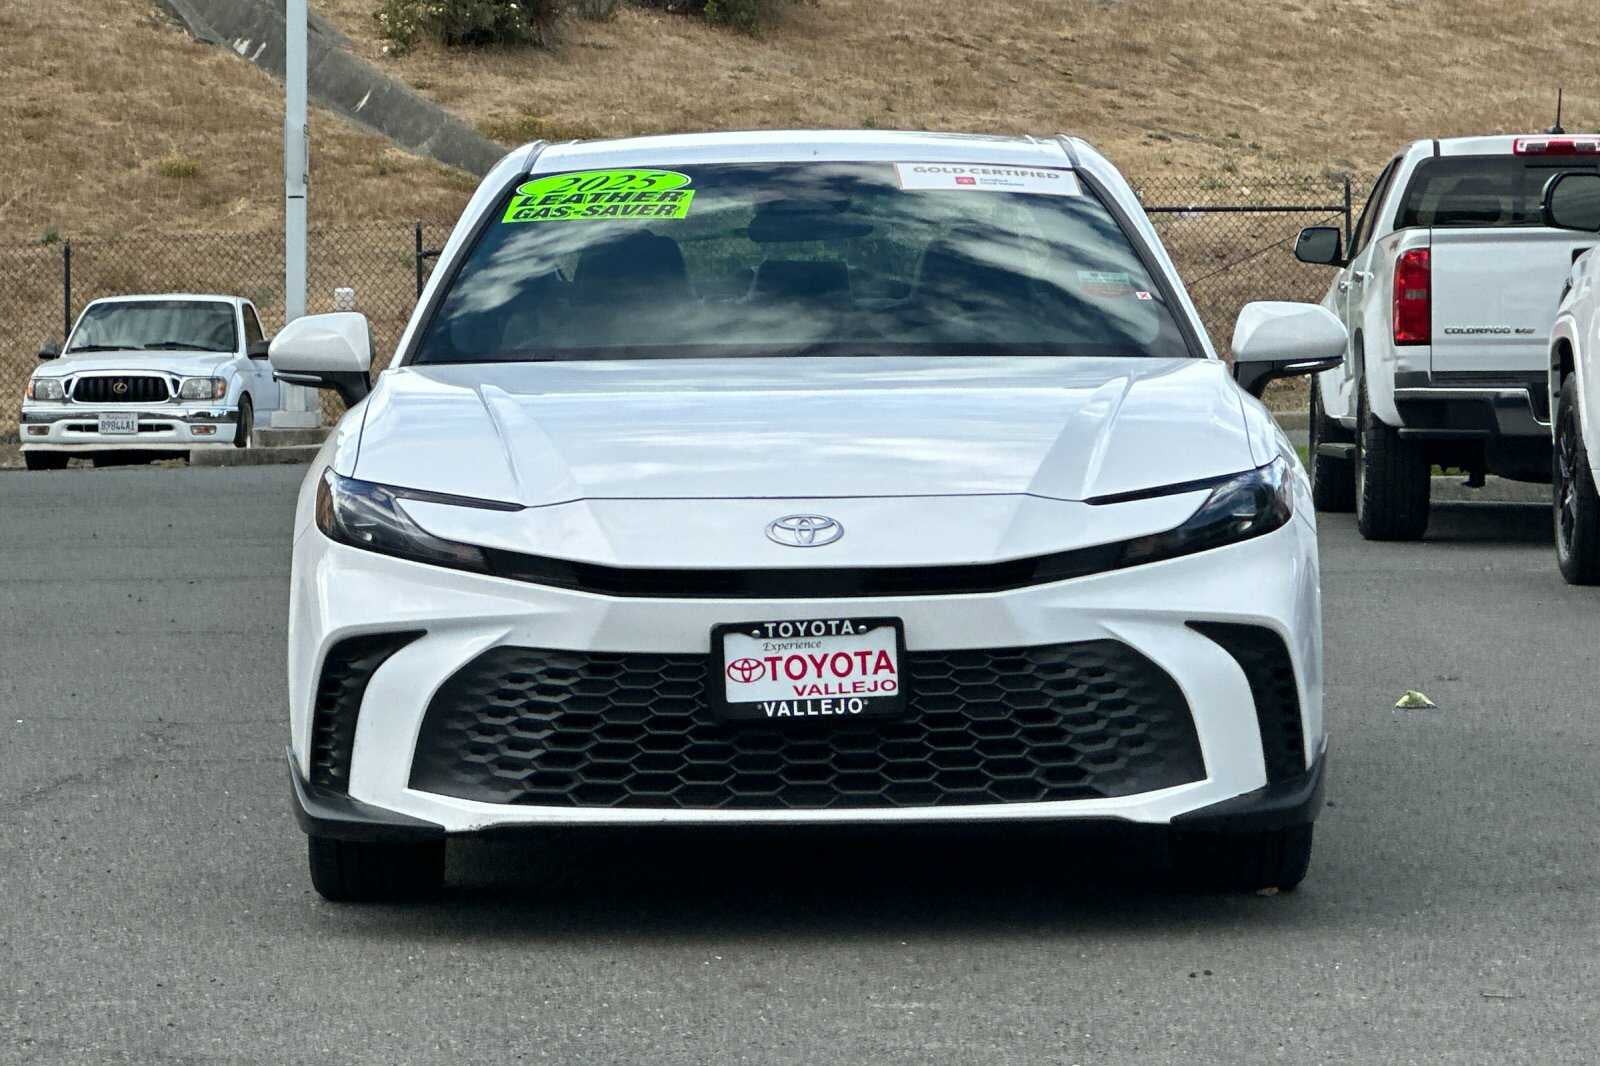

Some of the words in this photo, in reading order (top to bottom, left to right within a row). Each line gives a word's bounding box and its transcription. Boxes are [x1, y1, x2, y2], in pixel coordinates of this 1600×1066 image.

[913, 166, 965, 174] GOLD
[969, 167, 1060, 180] CERTIFIED
[544, 174, 667, 194] 2025
[515, 190, 686, 207] LEATHER
[512, 204, 678, 220] GAS-SAVER
[1444, 327, 1511, 335] COLORADO
[764, 620, 855, 638] TOYOTA
[762, 640, 822, 652] Experience
[764, 650, 896, 681] TOYOTA
[792, 679, 897, 697] VALLEJO
[763, 698, 863, 717] VALLEJO
